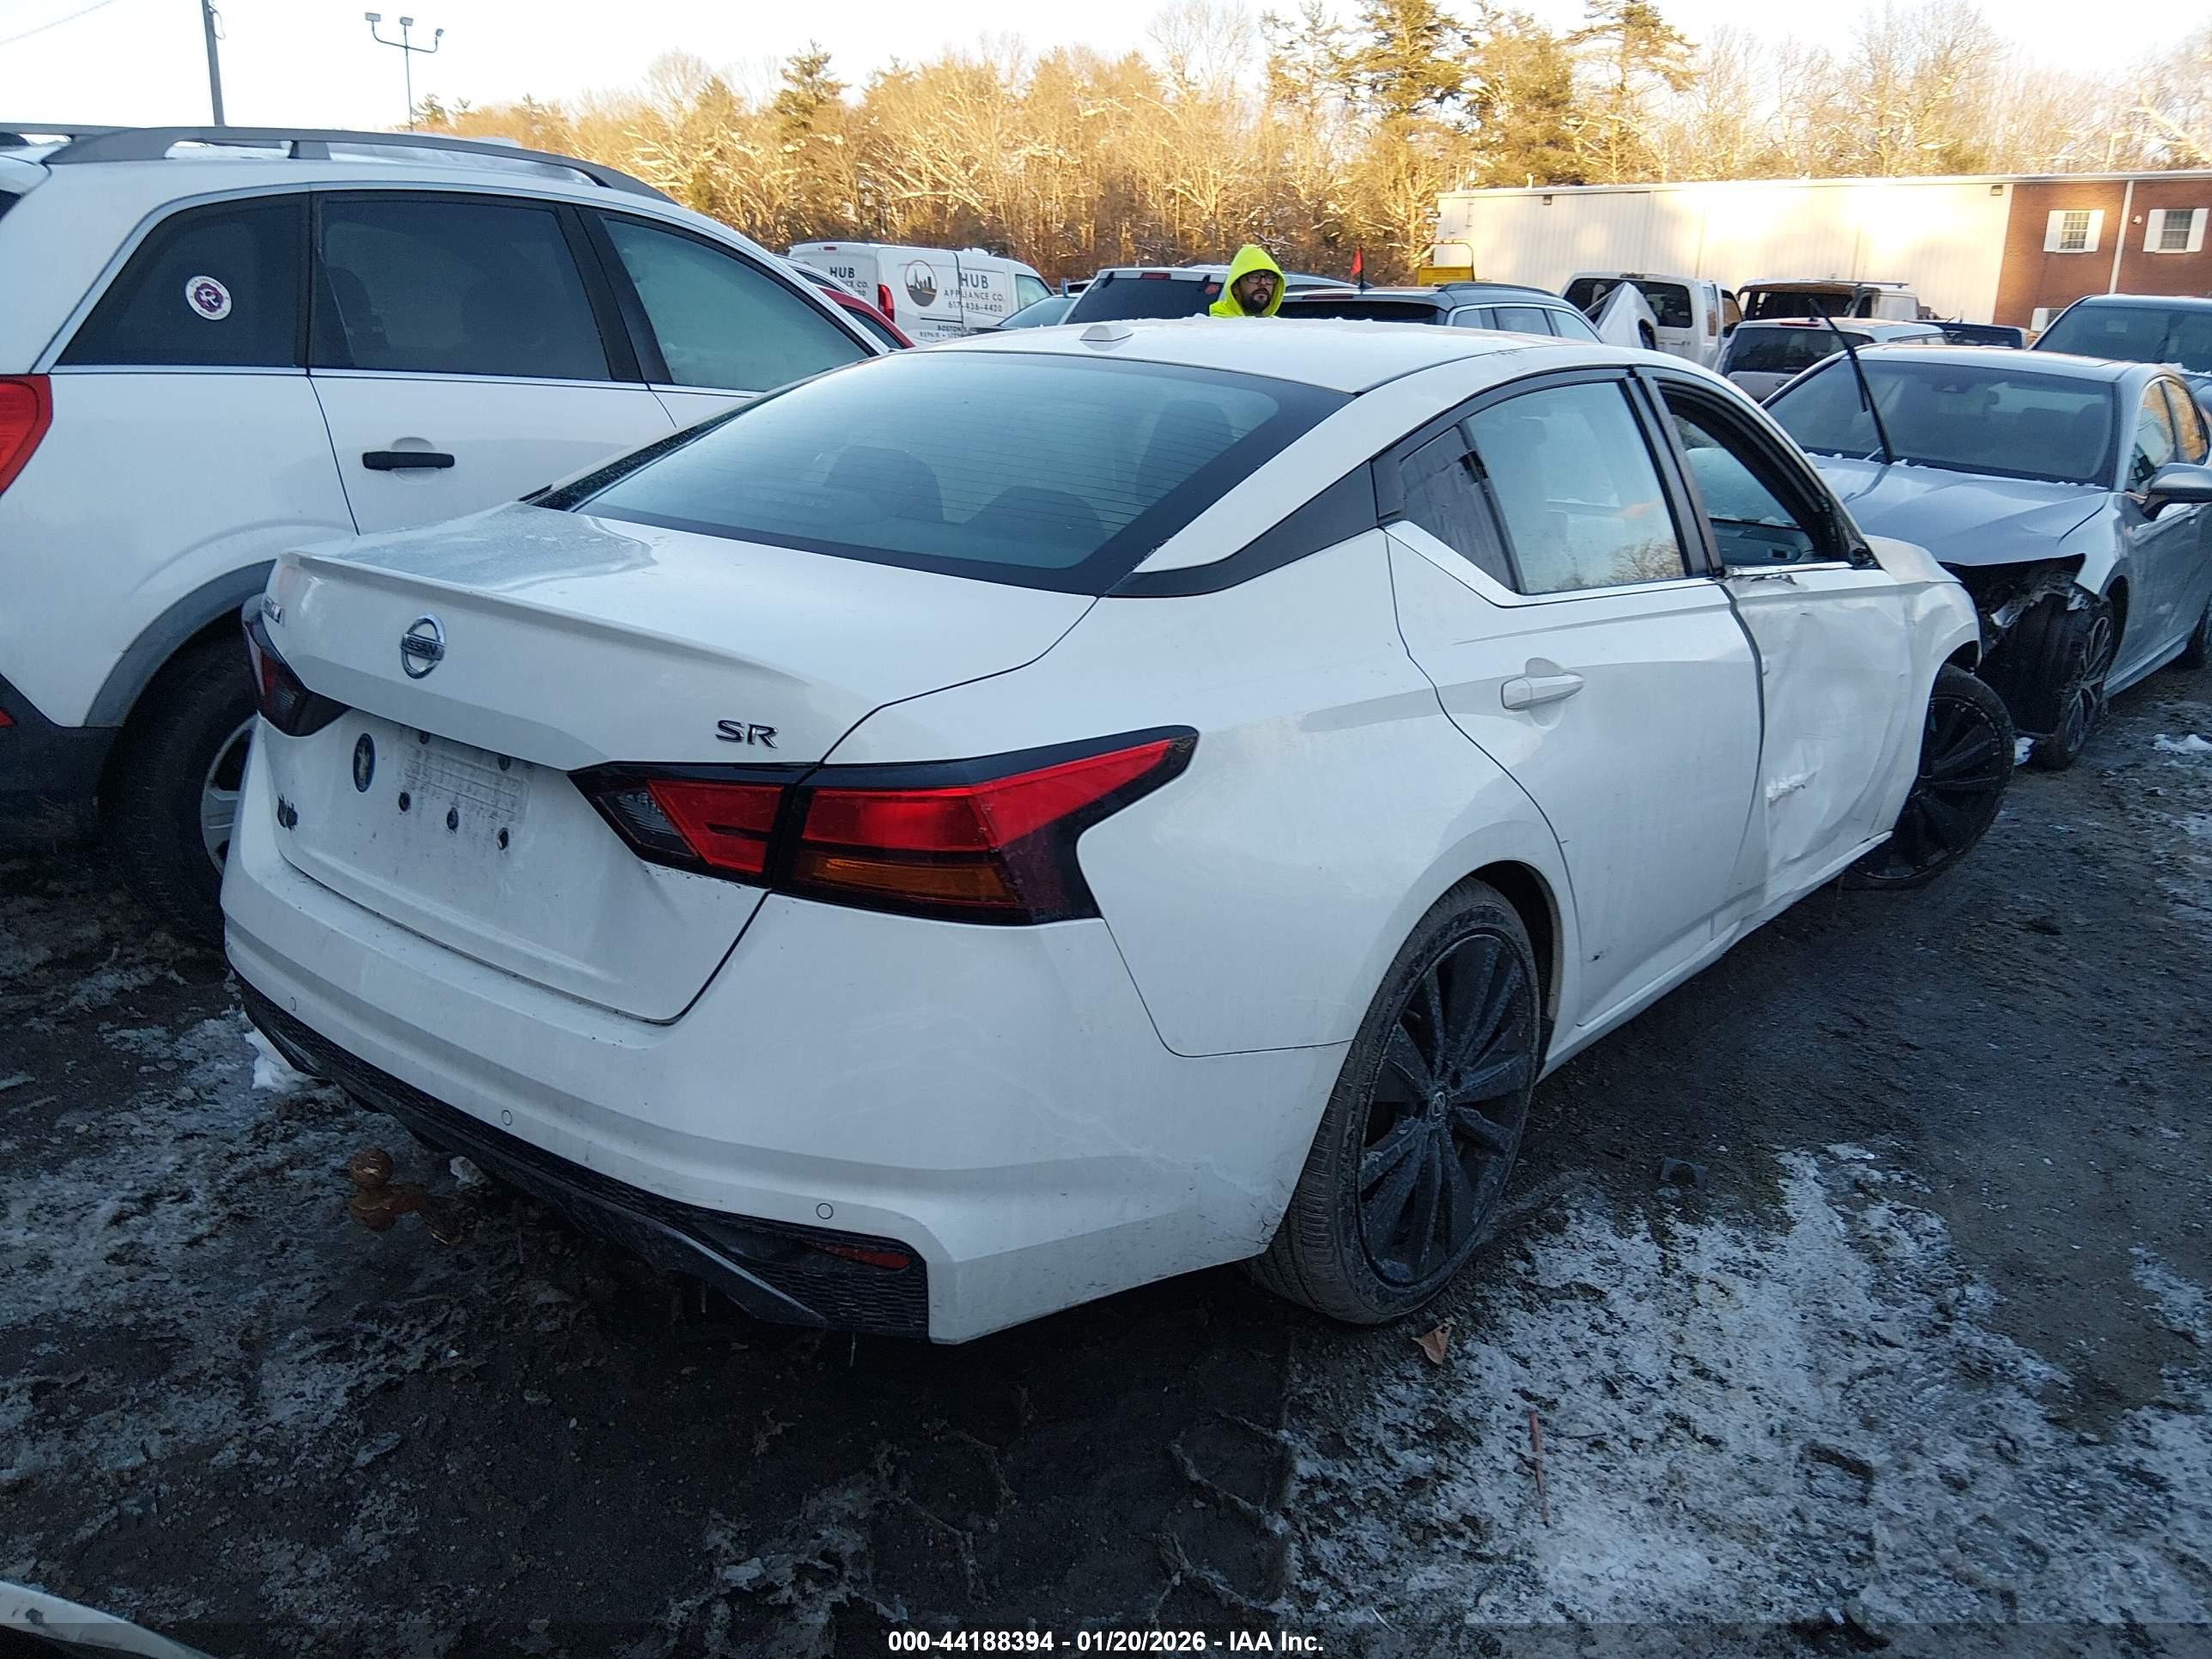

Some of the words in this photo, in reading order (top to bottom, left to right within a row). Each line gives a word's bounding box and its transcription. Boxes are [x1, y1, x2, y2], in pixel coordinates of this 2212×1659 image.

[830, 267, 855, 278] HUB
[960, 272, 989, 289] HUB
[944, 289, 989, 301] APPLIANCE
[992, 293, 1006, 302] CO.
[714, 720, 778, 749] SR
